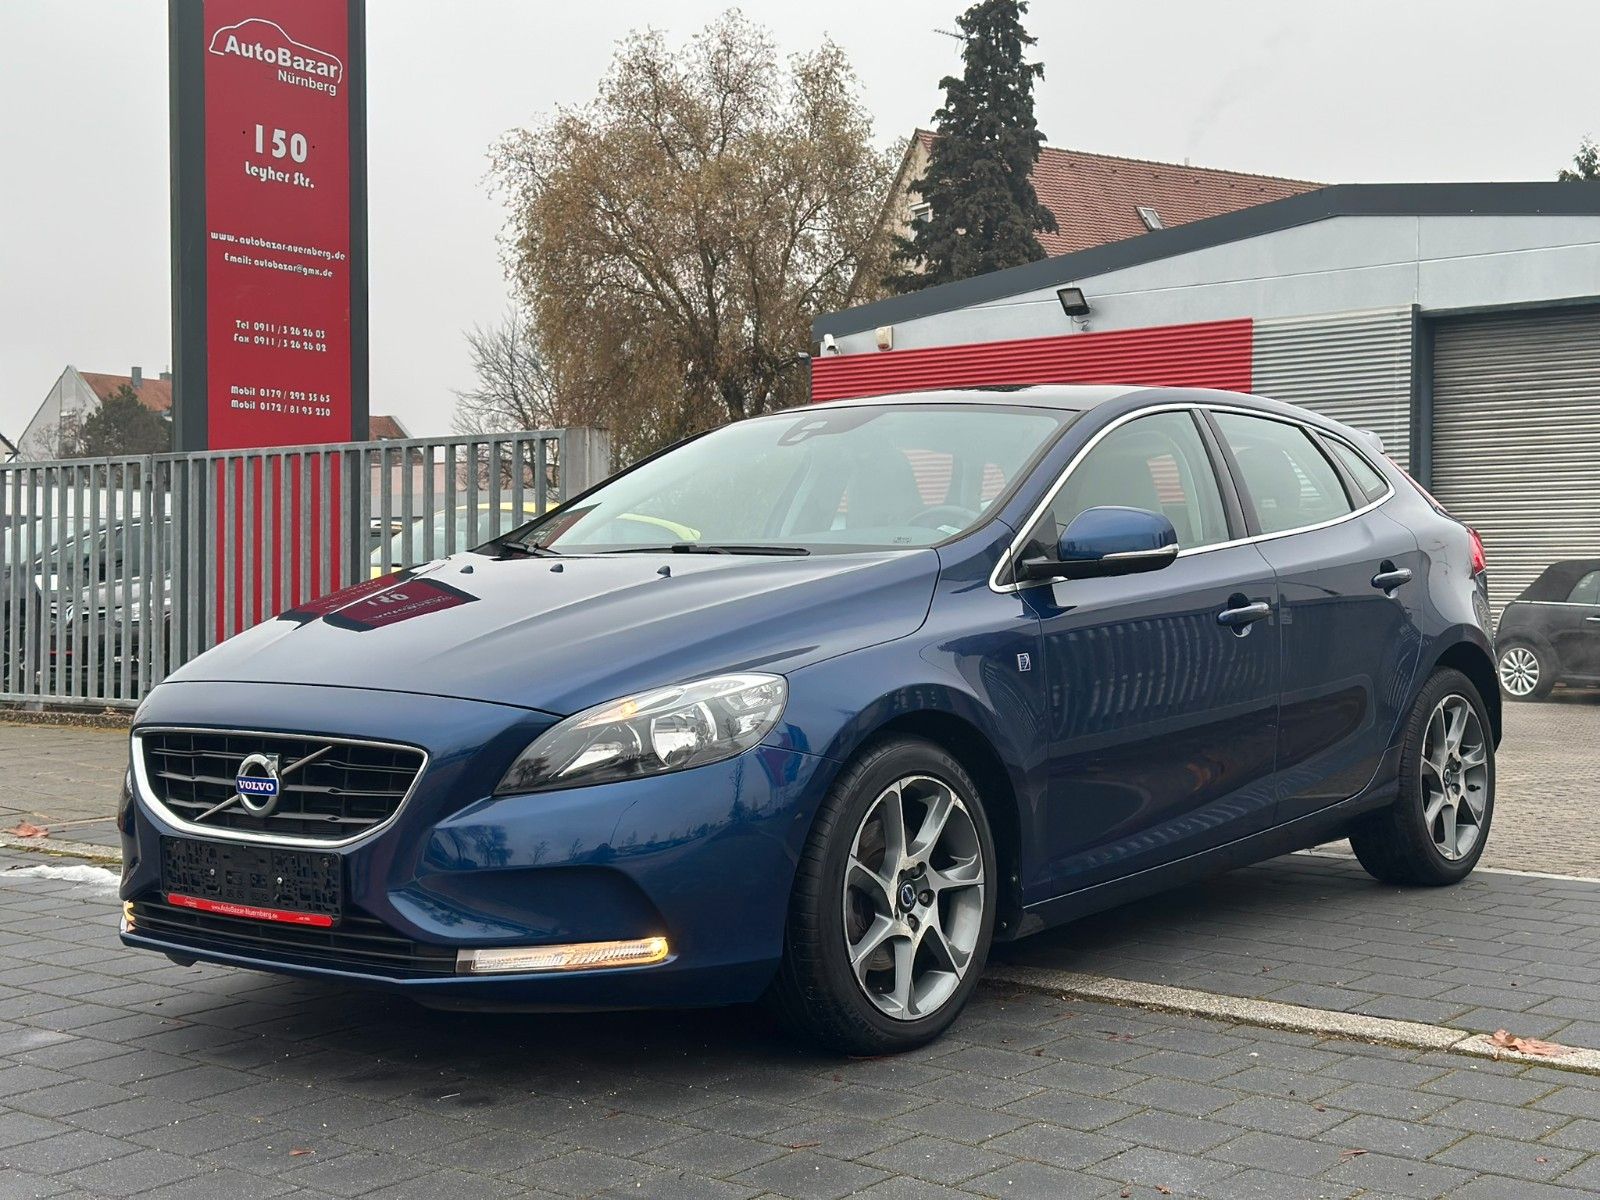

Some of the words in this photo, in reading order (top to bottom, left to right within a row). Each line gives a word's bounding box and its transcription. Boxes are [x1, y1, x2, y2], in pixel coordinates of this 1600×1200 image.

[224, 35, 338, 78] AutoBazar
[277, 69, 337, 97] Nürnberg
[255, 124, 308, 163] 150
[245, 161, 290, 182] Leyher
[293, 171, 315, 189] Str.
[210, 231, 346, 261] www.autobazar-nuernberg.de
[224, 252, 252, 265] Email:
[253, 259, 333, 278] autobazar@gmx.de
[235, 319, 250, 330] Tel
[253, 321, 275, 333] 0911
[289, 326, 301, 336] 26
[302, 328, 314, 338] 26
[233, 333, 250, 343] Fax
[253, 335, 275, 346] 0911
[290, 340, 301, 349] 26
[302, 341, 314, 351] 26
[315, 342, 327, 352] 02
[230, 385, 256, 396] Mobil
[319, 394, 330, 403] 65
[231, 399, 256, 410] Mobil
[259, 401, 282, 412] 0172
[289, 405, 300, 414] 81
[238, 780, 275, 792] VOLVO
